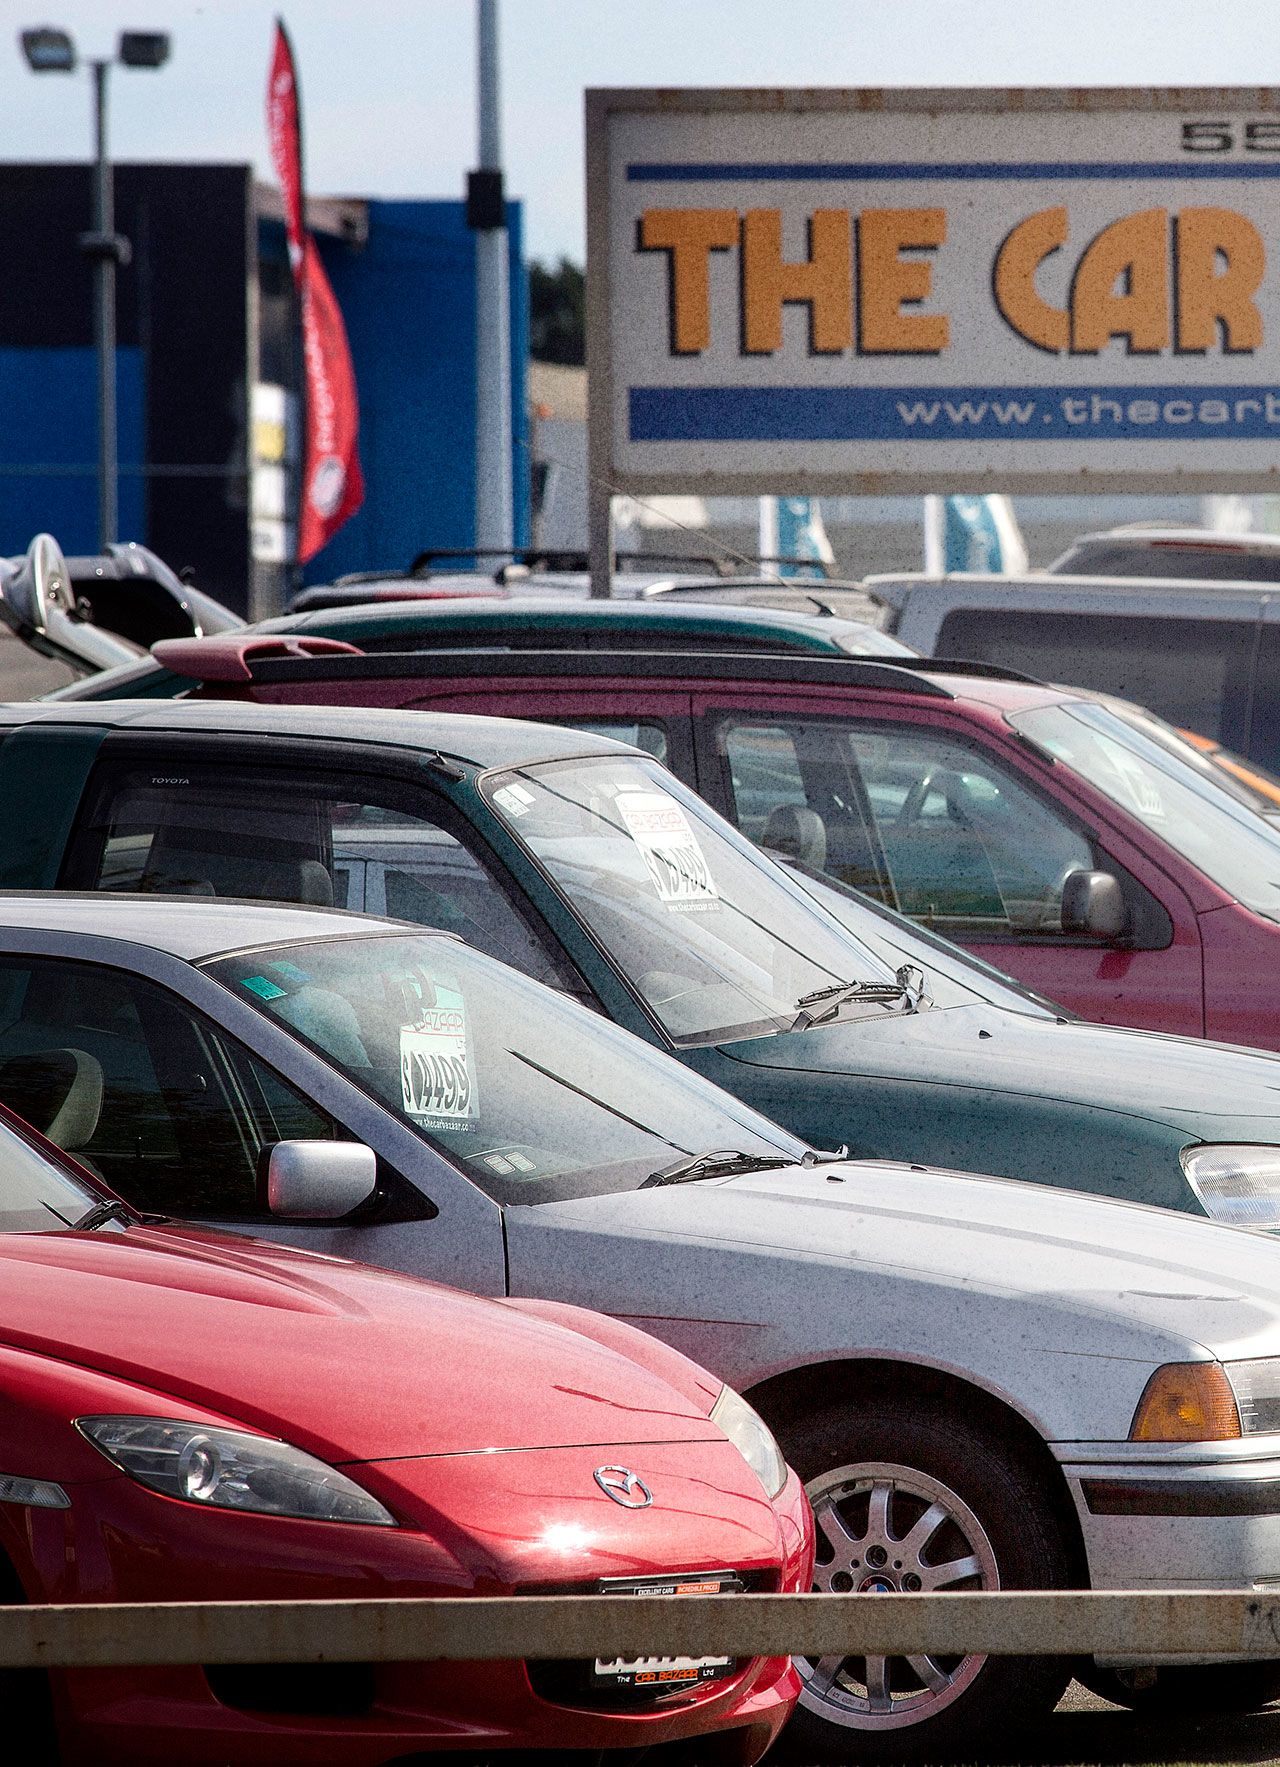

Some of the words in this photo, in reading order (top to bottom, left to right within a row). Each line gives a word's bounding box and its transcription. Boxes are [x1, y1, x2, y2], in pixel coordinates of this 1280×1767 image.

[635, 207, 950, 359] THE
[990, 205, 1266, 358] CAR
[151, 777, 190, 785] TOYOTA
[617, 1675, 631, 1683] The
[635, 1672, 656, 1683] CAR
[659, 1669, 698, 1681] BAZAAR
